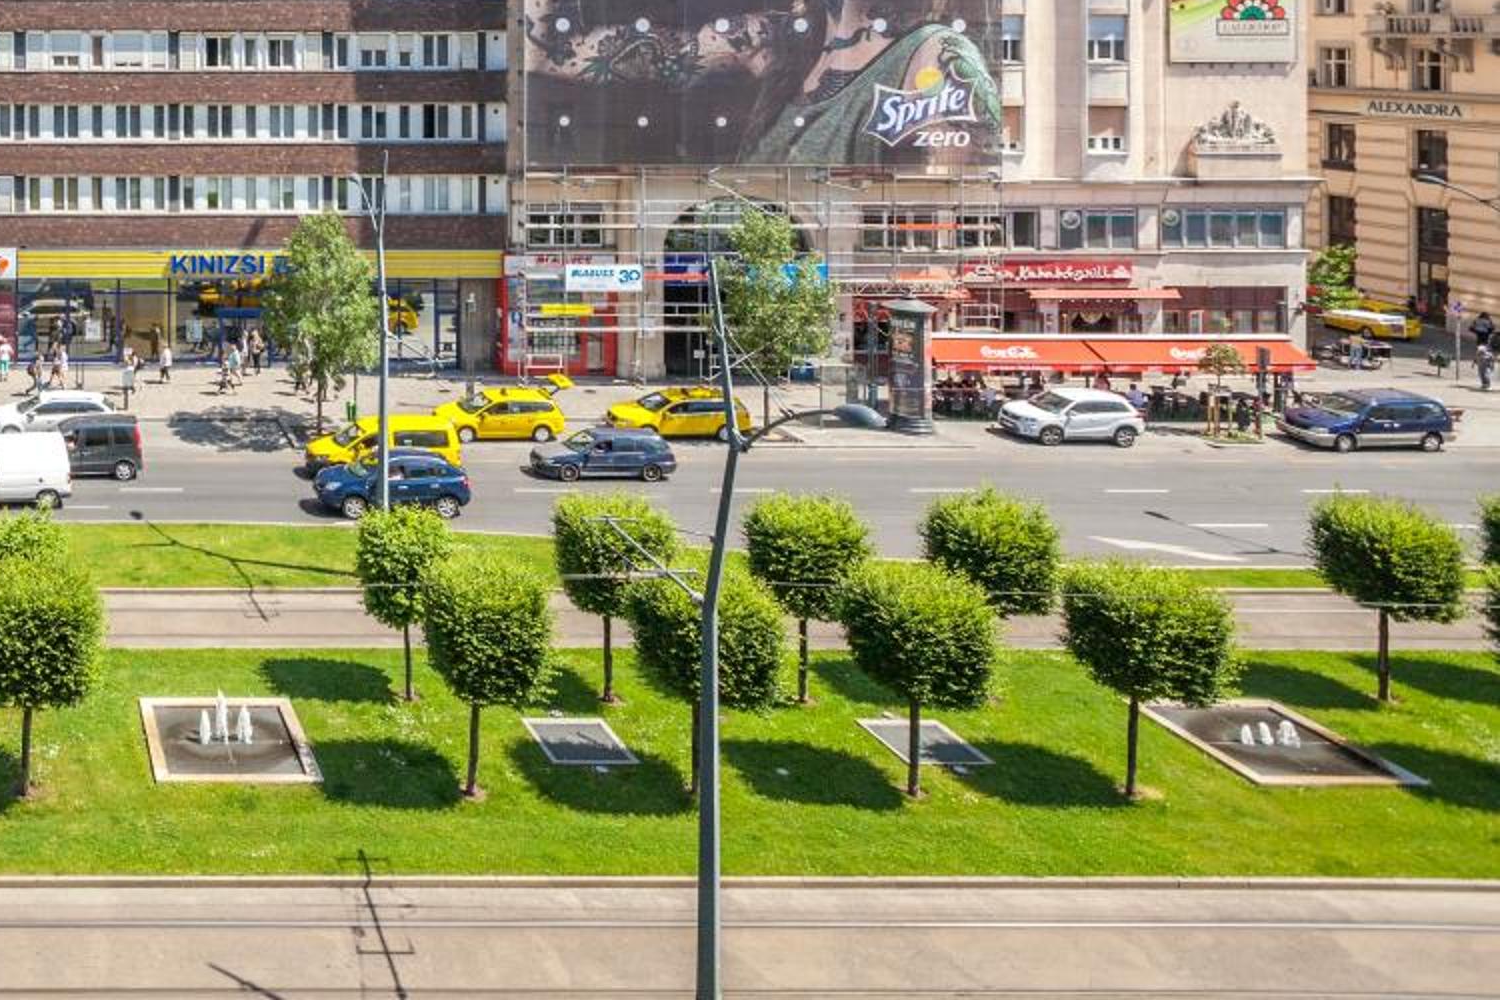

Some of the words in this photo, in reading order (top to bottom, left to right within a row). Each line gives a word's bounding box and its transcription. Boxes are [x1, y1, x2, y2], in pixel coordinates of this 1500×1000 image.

[876, 79, 966, 134] Sprite
[1367, 100, 1463, 117] ALEXANDRA
[912, 131, 971, 147] zero
[170, 255, 265, 274] KINIZSI
[618, 269, 642, 283] 30
